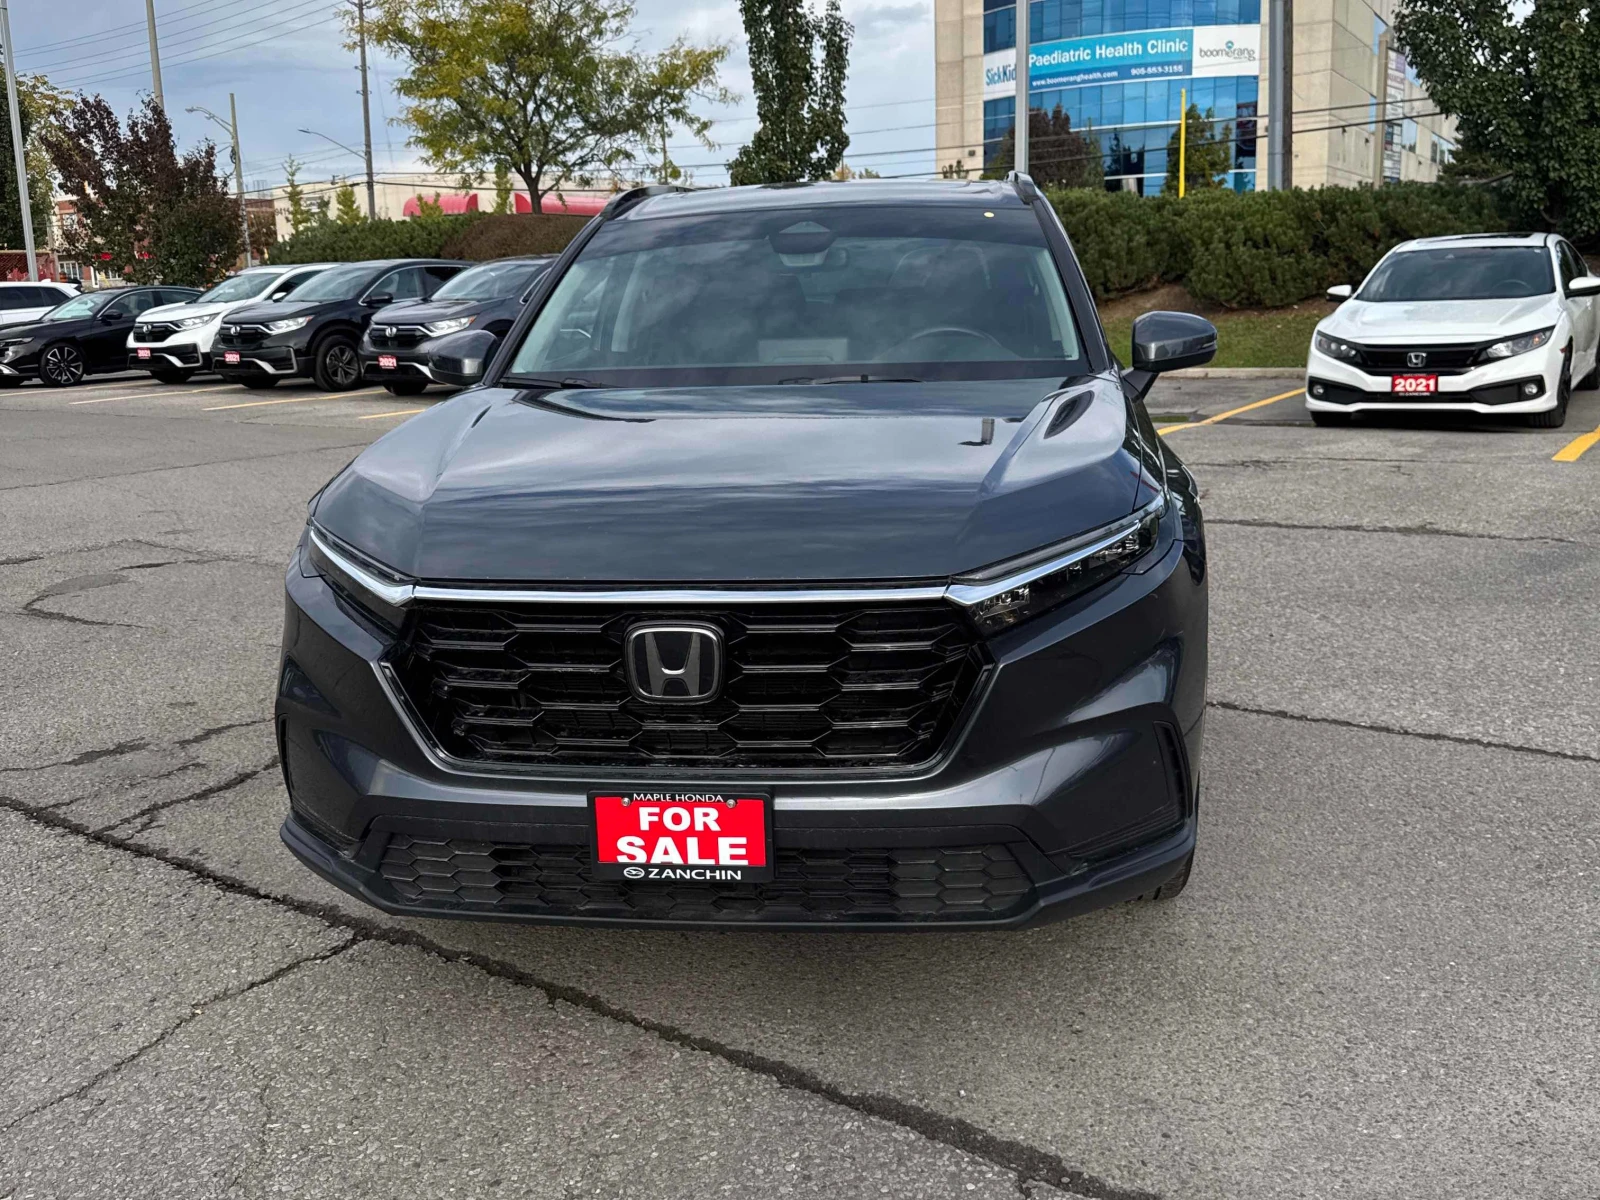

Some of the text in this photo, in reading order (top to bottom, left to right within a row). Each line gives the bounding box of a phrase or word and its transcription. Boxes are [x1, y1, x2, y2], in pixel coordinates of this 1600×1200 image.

[1029, 38, 1188, 67] Paediatric Health Clinic
[1199, 46, 1256, 61] boomerang
[986, 64, 1016, 86] SickKid
[1032, 71, 1118, 86] www.boomeranghealth.com
[1394, 378, 1436, 392] 2021
[633, 793, 724, 802] MAPLE HONDA
[638, 806, 721, 831] FOR
[616, 835, 749, 865] SALE
[648, 868, 742, 880] ZANCHIN
